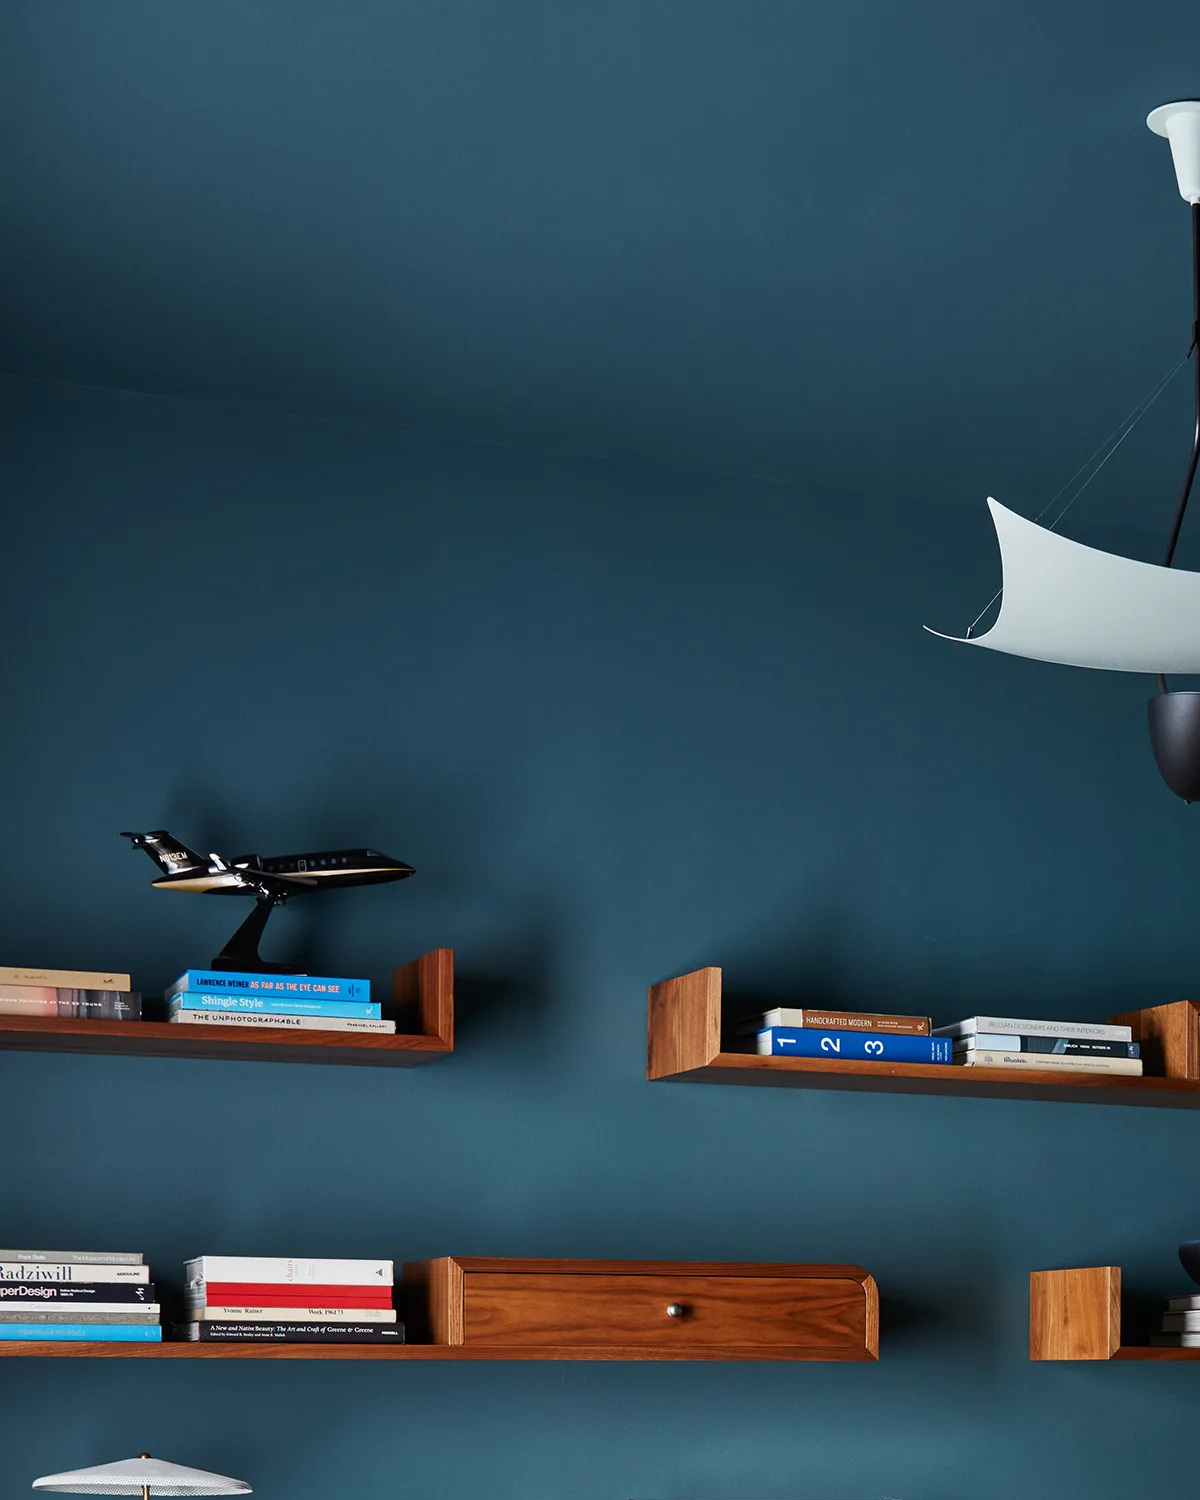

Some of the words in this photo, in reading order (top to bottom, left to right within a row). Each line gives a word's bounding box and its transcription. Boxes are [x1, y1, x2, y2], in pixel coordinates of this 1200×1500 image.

[196, 978, 227, 987] LAWRENCE
[227, 980, 249, 989] WEINER
[250, 981, 259, 989] AS
[261, 981, 274, 990] FAR
[275, 982, 285, 991] AS
[286, 982, 298, 991] THE
[299, 983, 311, 992] EYE
[313, 984, 326, 993] CAN
[327, 985, 340, 994] SEE
[201, 995, 238, 1008] Shingle
[239, 998, 264, 1009] Style
[192, 1013, 210, 1021] THE
[212, 1015, 301, 1026] UNPHOTOGRAPHABLE
[805, 1016, 848, 1027] HANDCRAFTED
[848, 1019, 873, 1028] MODERN
[988, 1020, 1013, 1029] BELGIAN
[1013, 1022, 1046, 1032] DESIGNERS
[1046, 1025, 1059, 1033] AND
[1059, 1026, 1076, 1034] THEIR
[1076, 1027, 1106, 1035] INTERIORS
[776, 1037, 797, 1047] 1
[820, 1037, 841, 1053] 2
[864, 1040, 884, 1055] 3
[0, 1265, 73, 1281] Radziwill
[285, 1260, 293, 1282] chairs
[0, 1285, 57, 1299] perDesign
[306, 1326, 319, 1334] Craft
[320, 1326, 327, 1334] of
